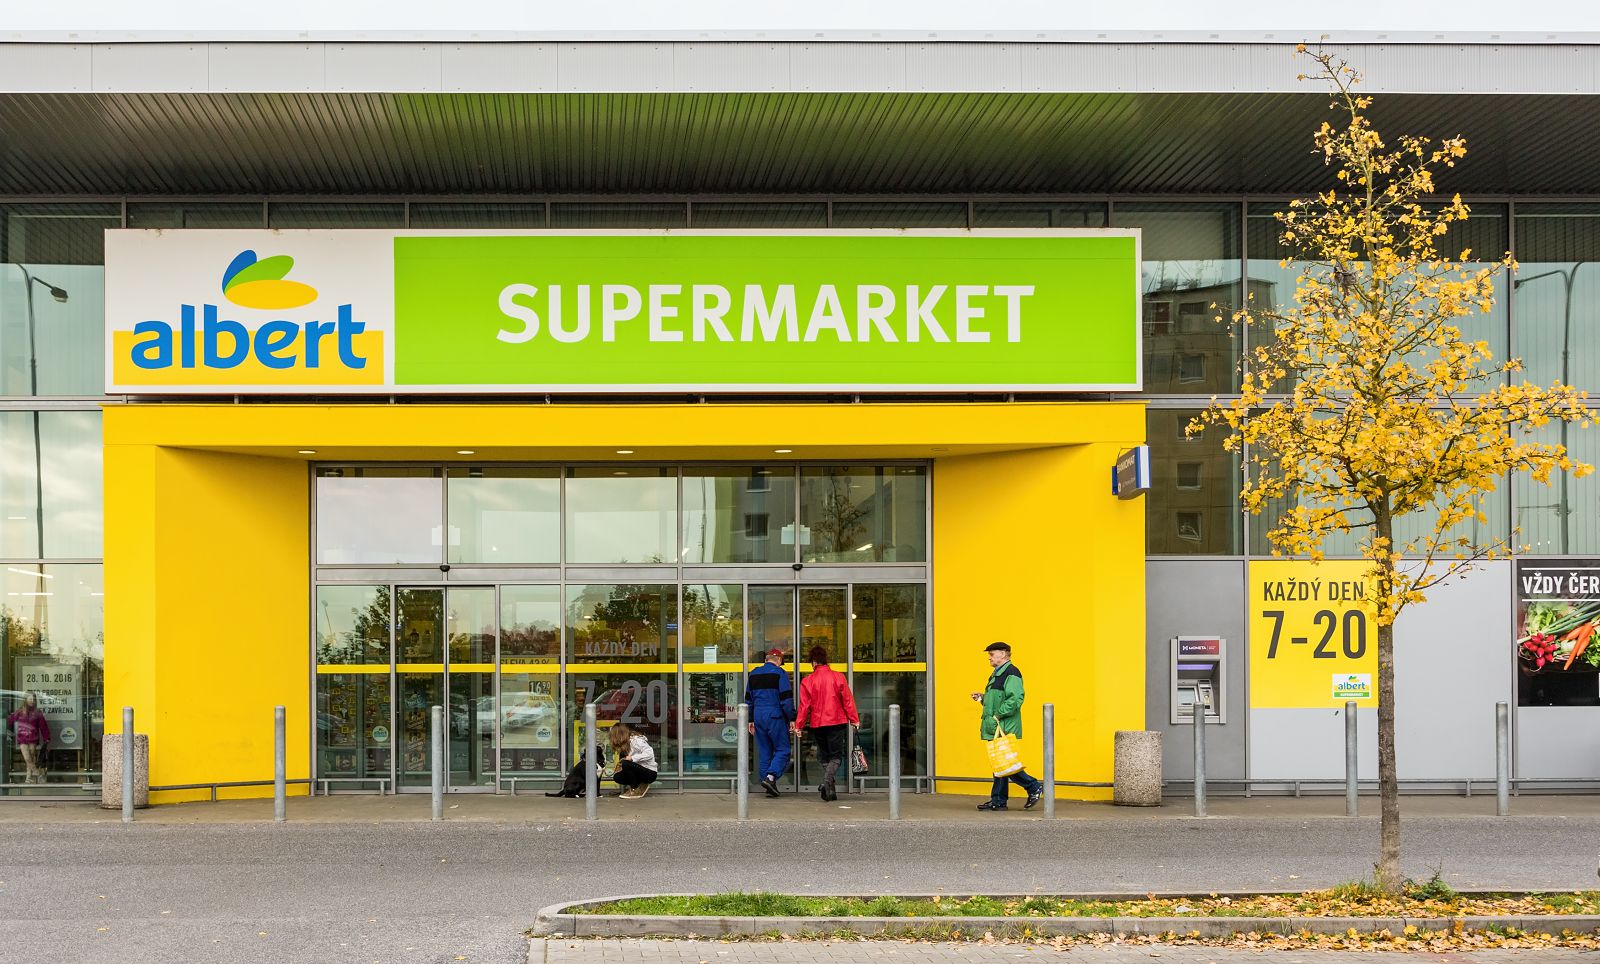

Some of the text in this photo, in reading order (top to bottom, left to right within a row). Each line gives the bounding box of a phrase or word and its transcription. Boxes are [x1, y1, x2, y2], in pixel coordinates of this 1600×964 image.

[496, 283, 1036, 344] SUPERMARKET
[131, 303, 367, 370] albert
[1263, 577, 1364, 601] KAŽDÝ DEN
[1522, 572, 1600, 594] VŽDY ČER
[1262, 610, 1366, 659] 7-20
[585, 638, 657, 656] KAŽDÝ DEN
[26, 673, 73, 683] 28. 10. 2016
[1338, 682, 1366, 690] albert
[575, 679, 668, 724] 7-20
